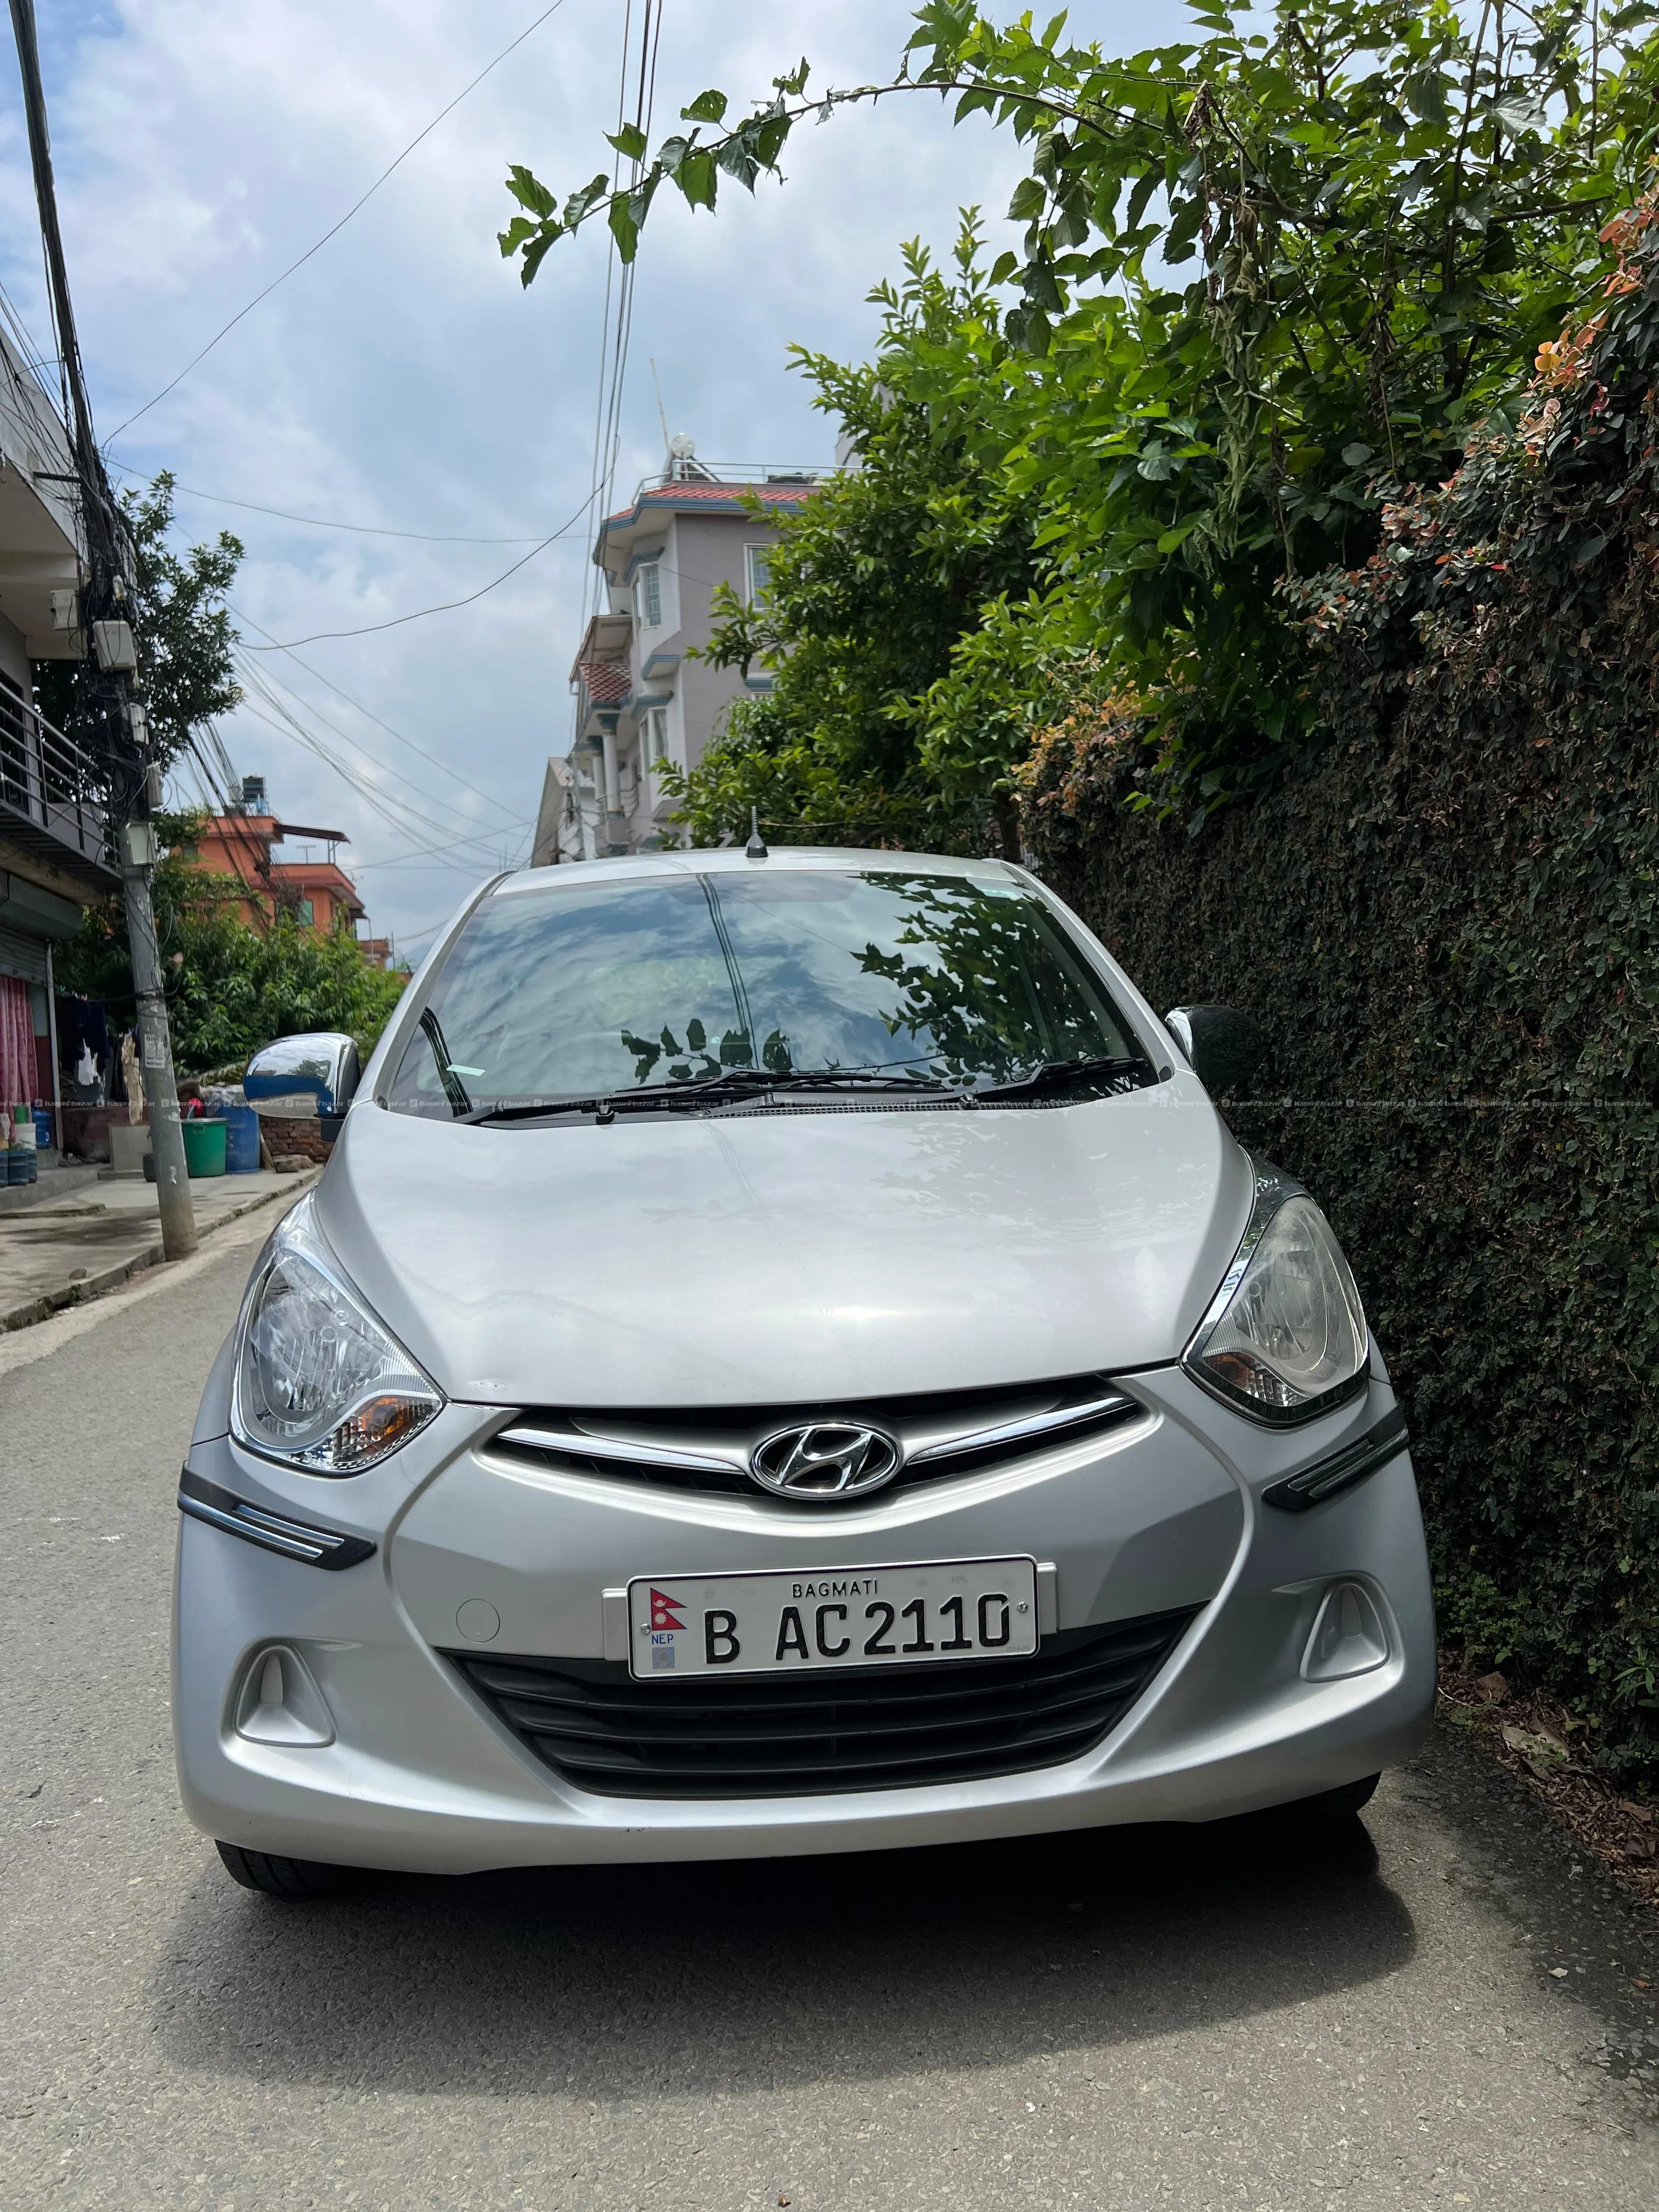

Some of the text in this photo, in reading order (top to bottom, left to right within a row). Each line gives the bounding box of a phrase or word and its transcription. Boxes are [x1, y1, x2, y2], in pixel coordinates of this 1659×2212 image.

[792, 1580, 877, 1598] BAGMATI
[652, 1634, 674, 1645] NEP
[704, 1610, 740, 1664] B
